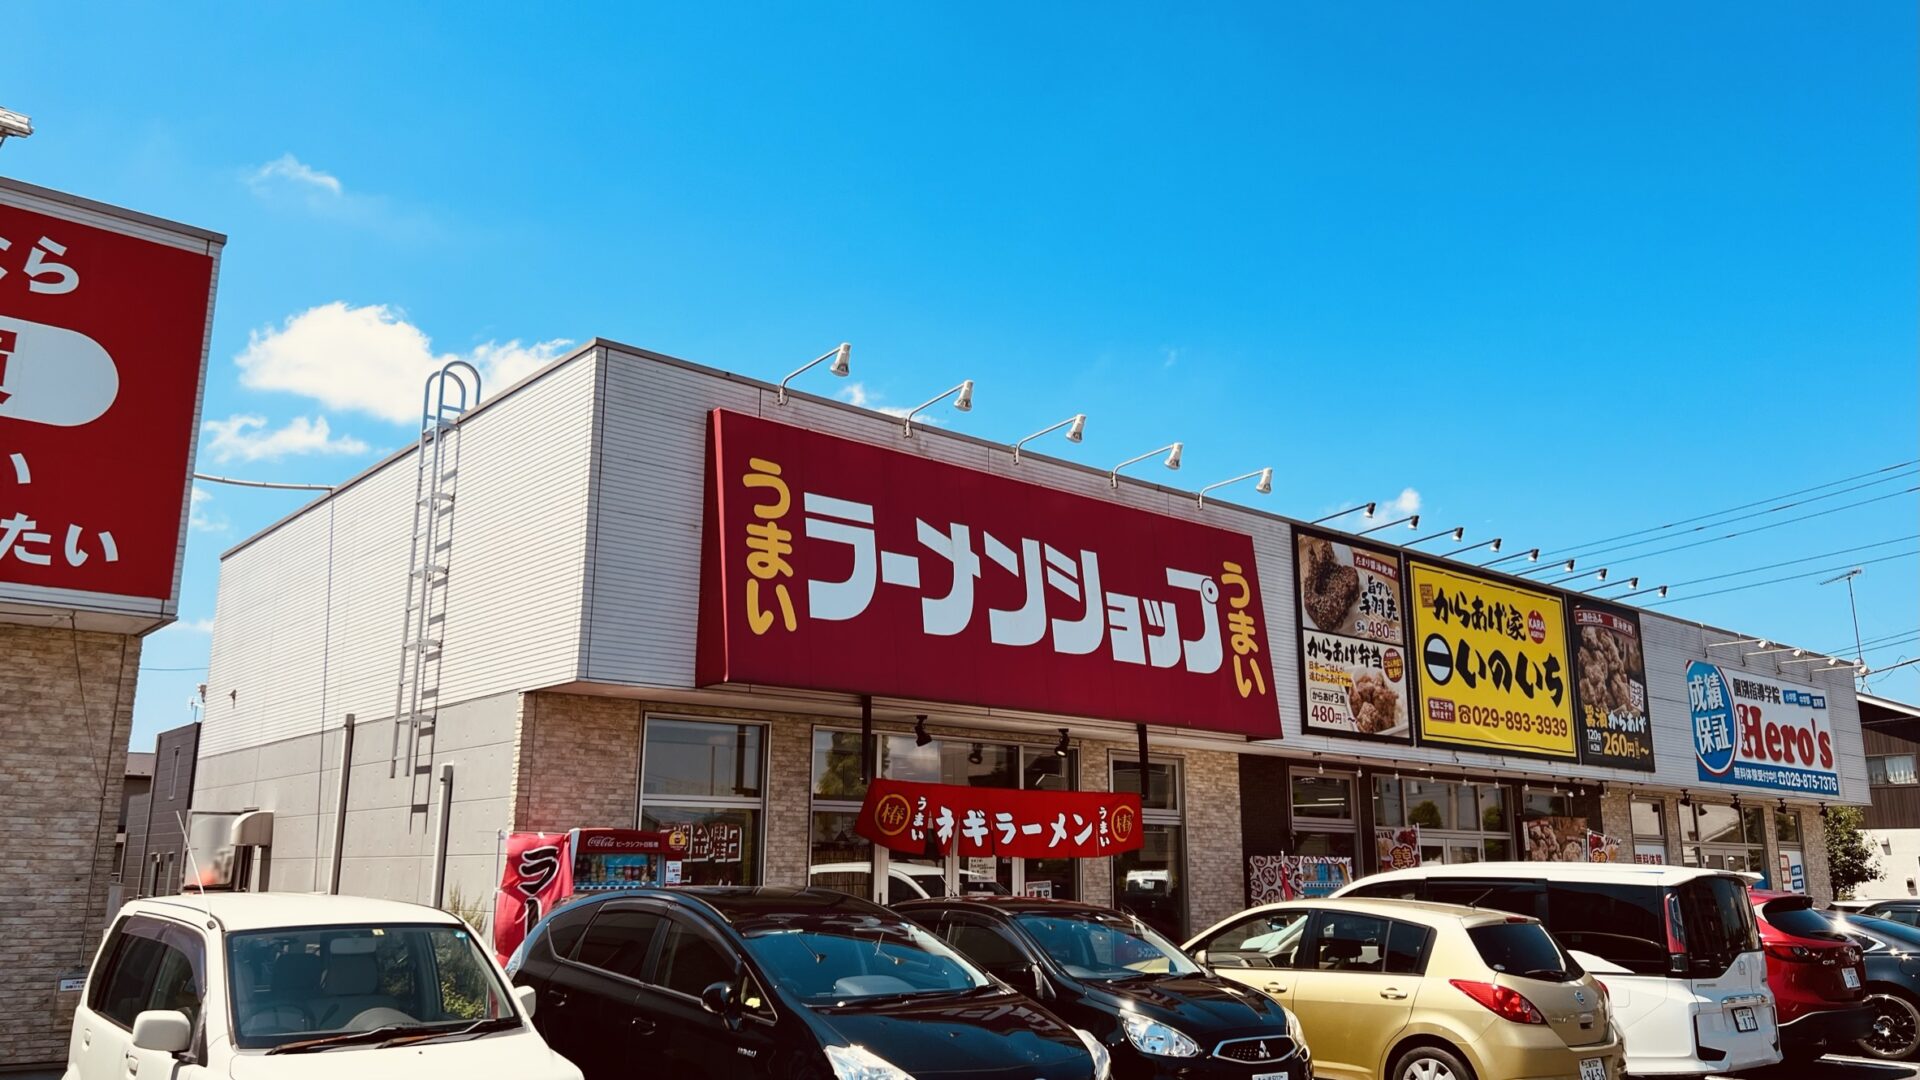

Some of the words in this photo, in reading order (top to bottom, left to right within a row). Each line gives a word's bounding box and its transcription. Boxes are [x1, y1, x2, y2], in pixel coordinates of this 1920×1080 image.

[0, 235, 80, 294] ら
[743, 457, 797, 635] うまい
[803, 491, 1224, 675] ラーメンショップ
[1221, 561, 1266, 699] うまい
[1359, 592, 1399, 621] 手羽先
[1433, 587, 1526, 641] からあげ家
[1369, 621, 1396, 640] 480円
[1307, 636, 1382, 669] からあげ弁当
[1455, 638, 1564, 707] いのいち
[1732, 677, 1781, 705] 個別指導学院
[1688, 672, 1725, 713] 成績
[1311, 705, 1342, 724] 480円
[1472, 705, 1567, 738] 029-893-3939
[1603, 731, 1635, 758] 260円
[1695, 713, 1732, 756] 保証
[1736, 703, 1834, 770] Hero's
[1785, 770, 1838, 792] 029-875-7376
[882, 802, 905, 826] 椿
[911, 796, 927, 841] うまい
[935, 804, 1092, 848] ネギラーメン
[1098, 806, 1110, 847] うまい
